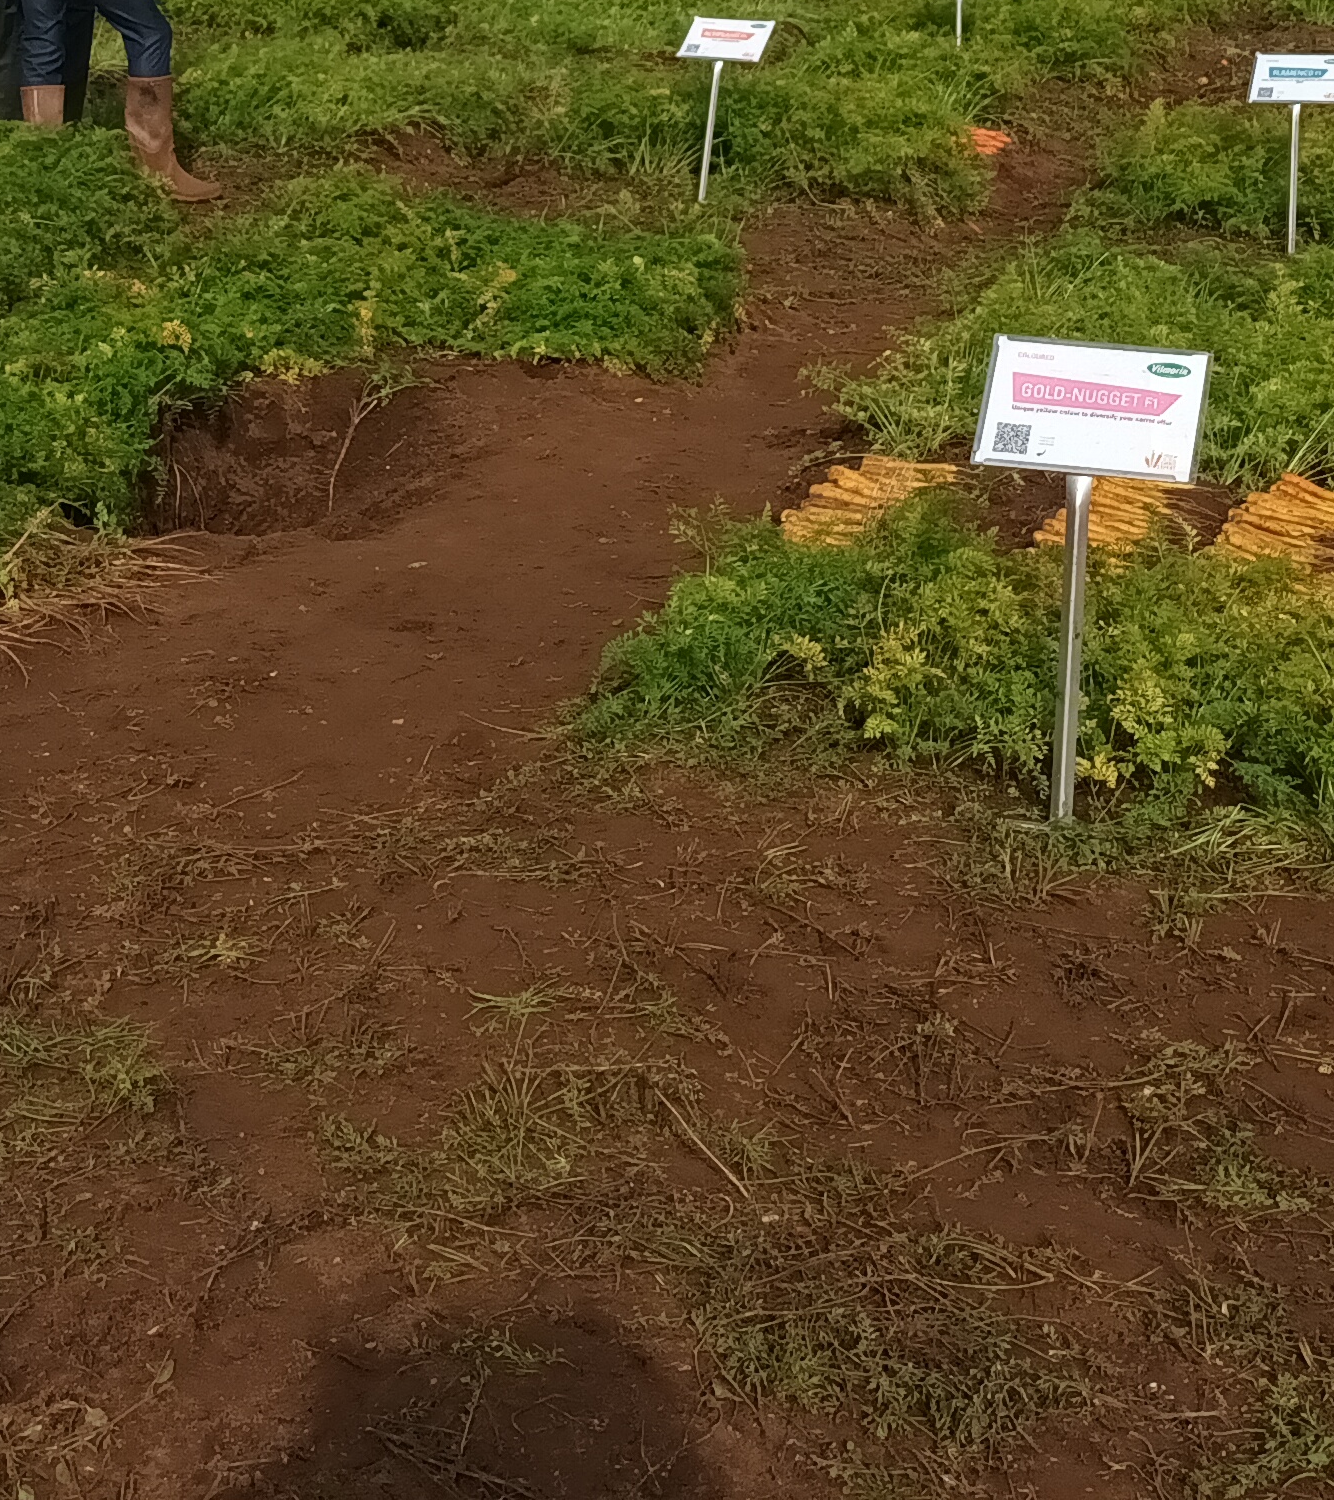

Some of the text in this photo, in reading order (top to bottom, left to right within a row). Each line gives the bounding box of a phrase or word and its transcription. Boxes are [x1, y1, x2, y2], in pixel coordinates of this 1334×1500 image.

[1018, 351, 1055, 361] COLOURED
[1151, 364, 1189, 376] Vilmorin
[1021, 382, 1158, 409] GOLD-NUGGET F1
